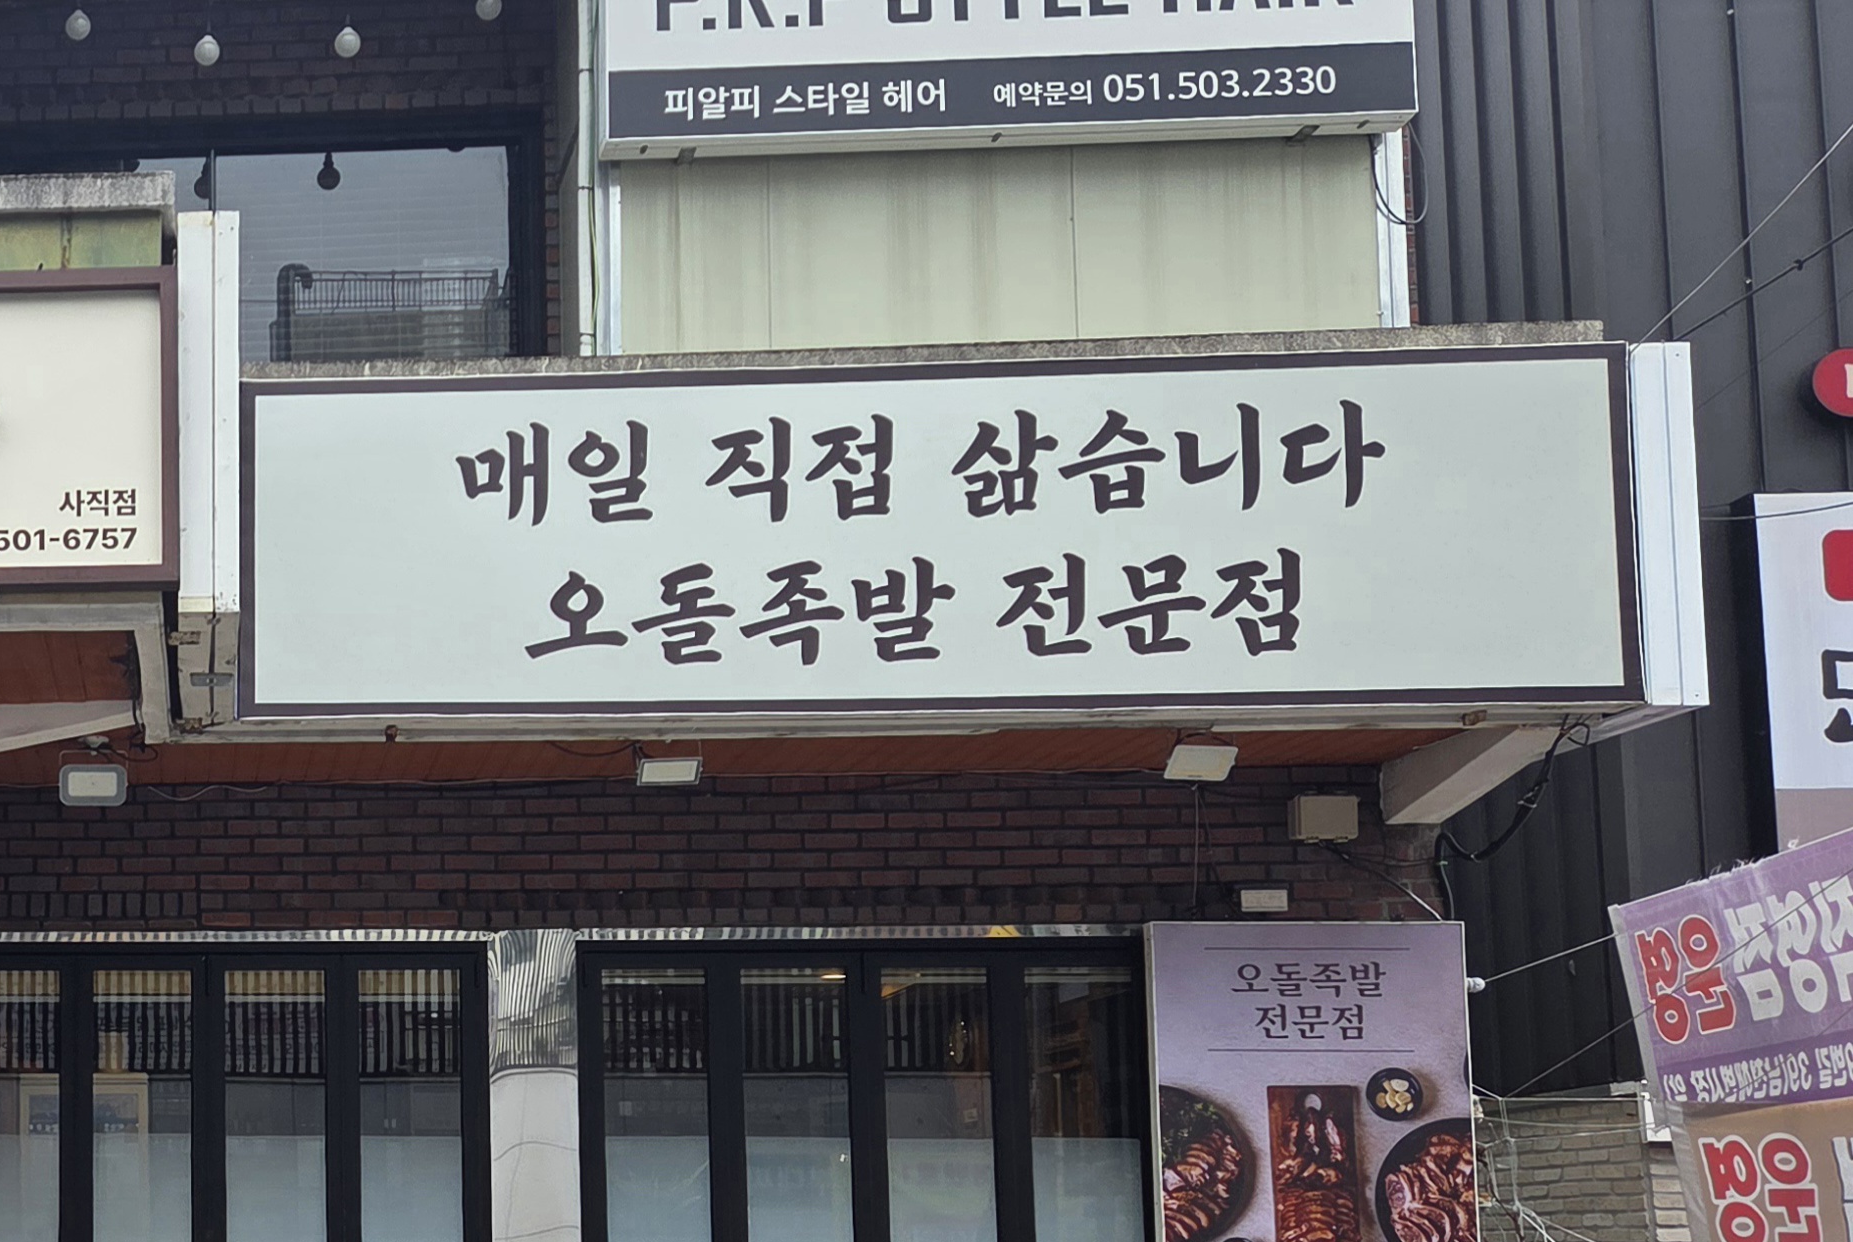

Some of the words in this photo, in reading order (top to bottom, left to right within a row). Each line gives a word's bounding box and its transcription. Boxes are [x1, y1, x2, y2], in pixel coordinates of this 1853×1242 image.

[664, 85, 760, 120] 피알피
[773, 82, 870, 116] 스타일
[882, 78, 946, 113] 헤어
[993, 80, 1092, 107] 예약문의
[1103, 66, 1337, 102] 051.503.2330
[455, 419, 655, 527] 매일
[703, 414, 895, 523] 직접
[949, 400, 1386, 518] 삶습니다
[59, 488, 136, 517] 사직점
[523, 554, 955, 666] 오돌족발
[995, 546, 1304, 658] 전문점
[1231, 961, 1387, 998] 오돌족발
[1255, 1003, 1364, 1040] 전문점
